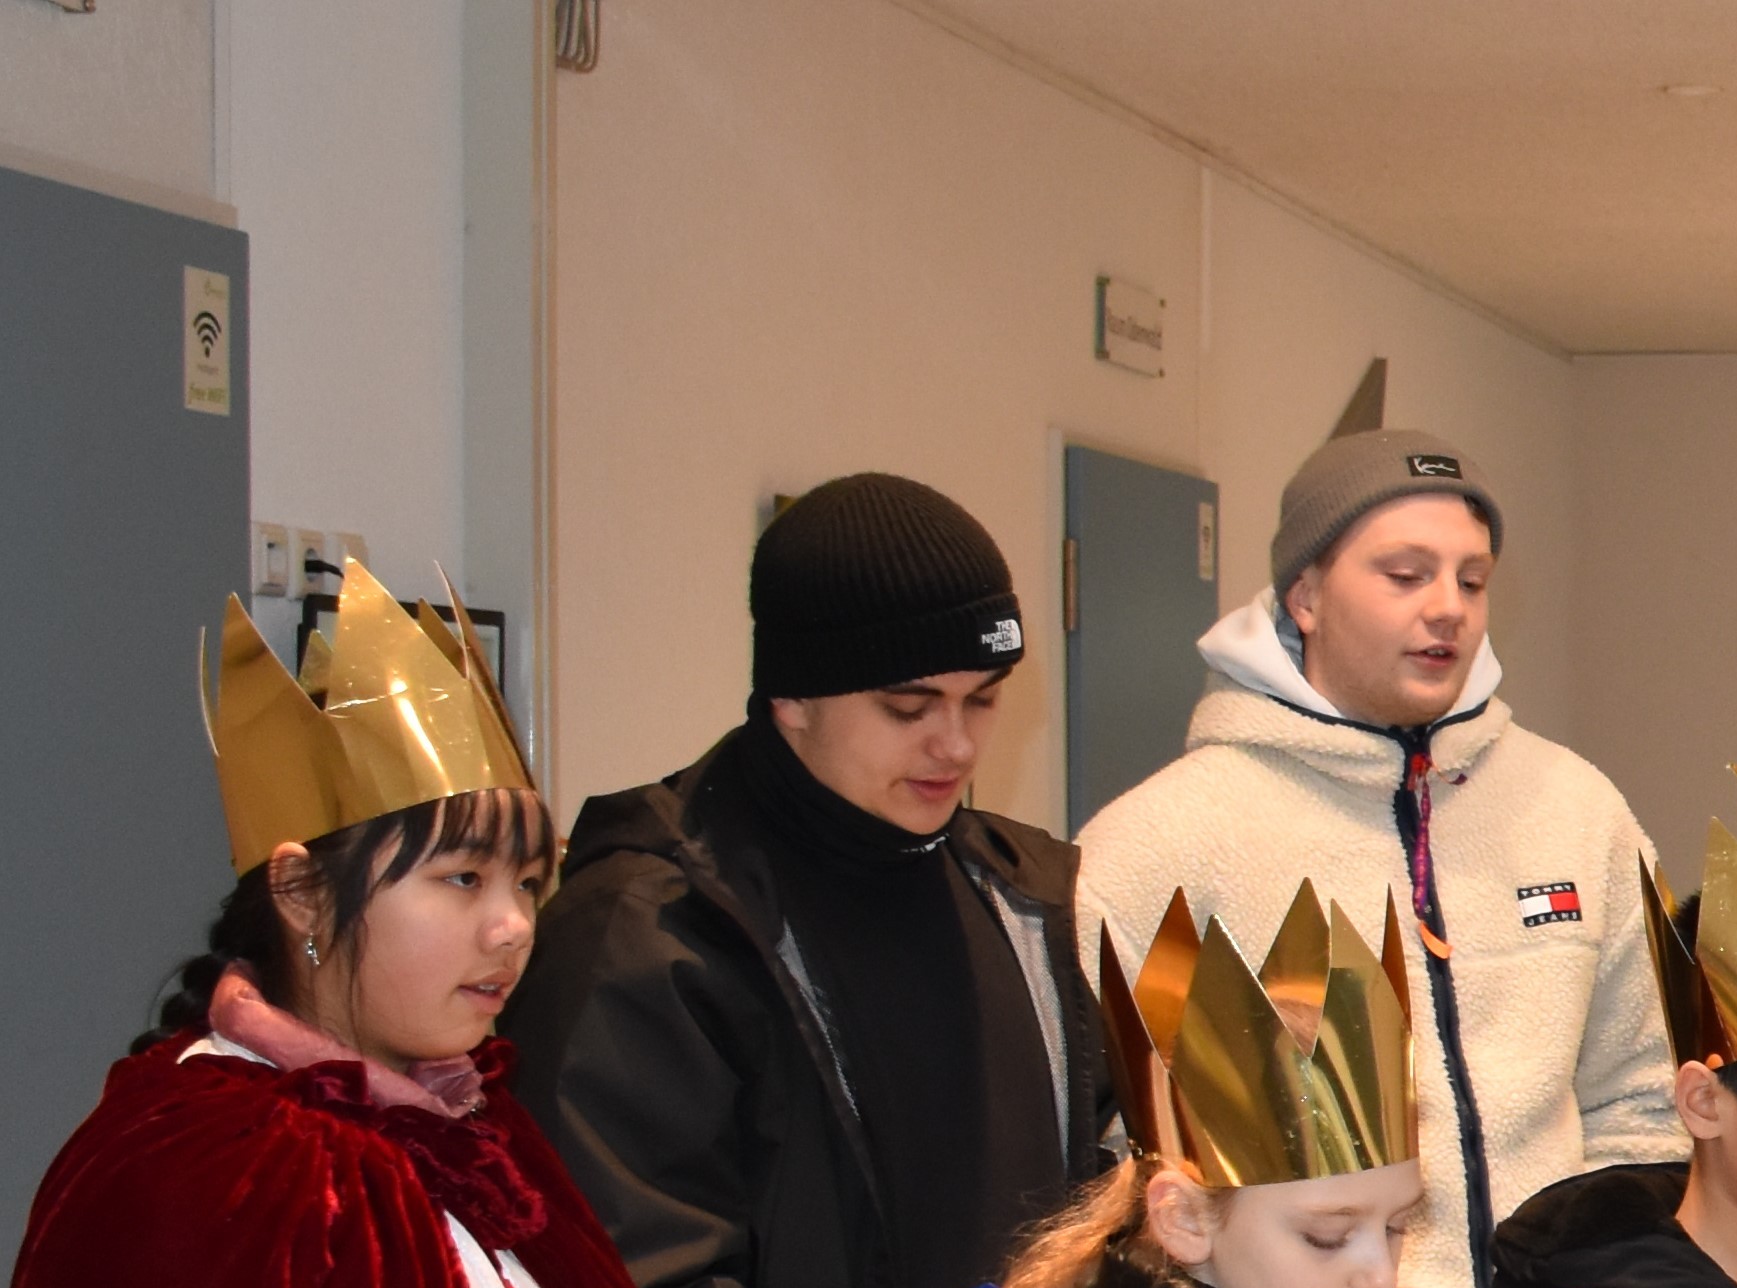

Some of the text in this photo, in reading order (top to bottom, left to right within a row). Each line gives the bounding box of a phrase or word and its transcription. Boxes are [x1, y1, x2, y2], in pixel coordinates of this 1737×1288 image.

[995, 620, 1012, 631] THE
[981, 631, 1012, 645] NORTH
[992, 641, 1013, 653] FACE
[1520, 884, 1572, 897] TOMMY
[1528, 911, 1578, 926] JEANS
